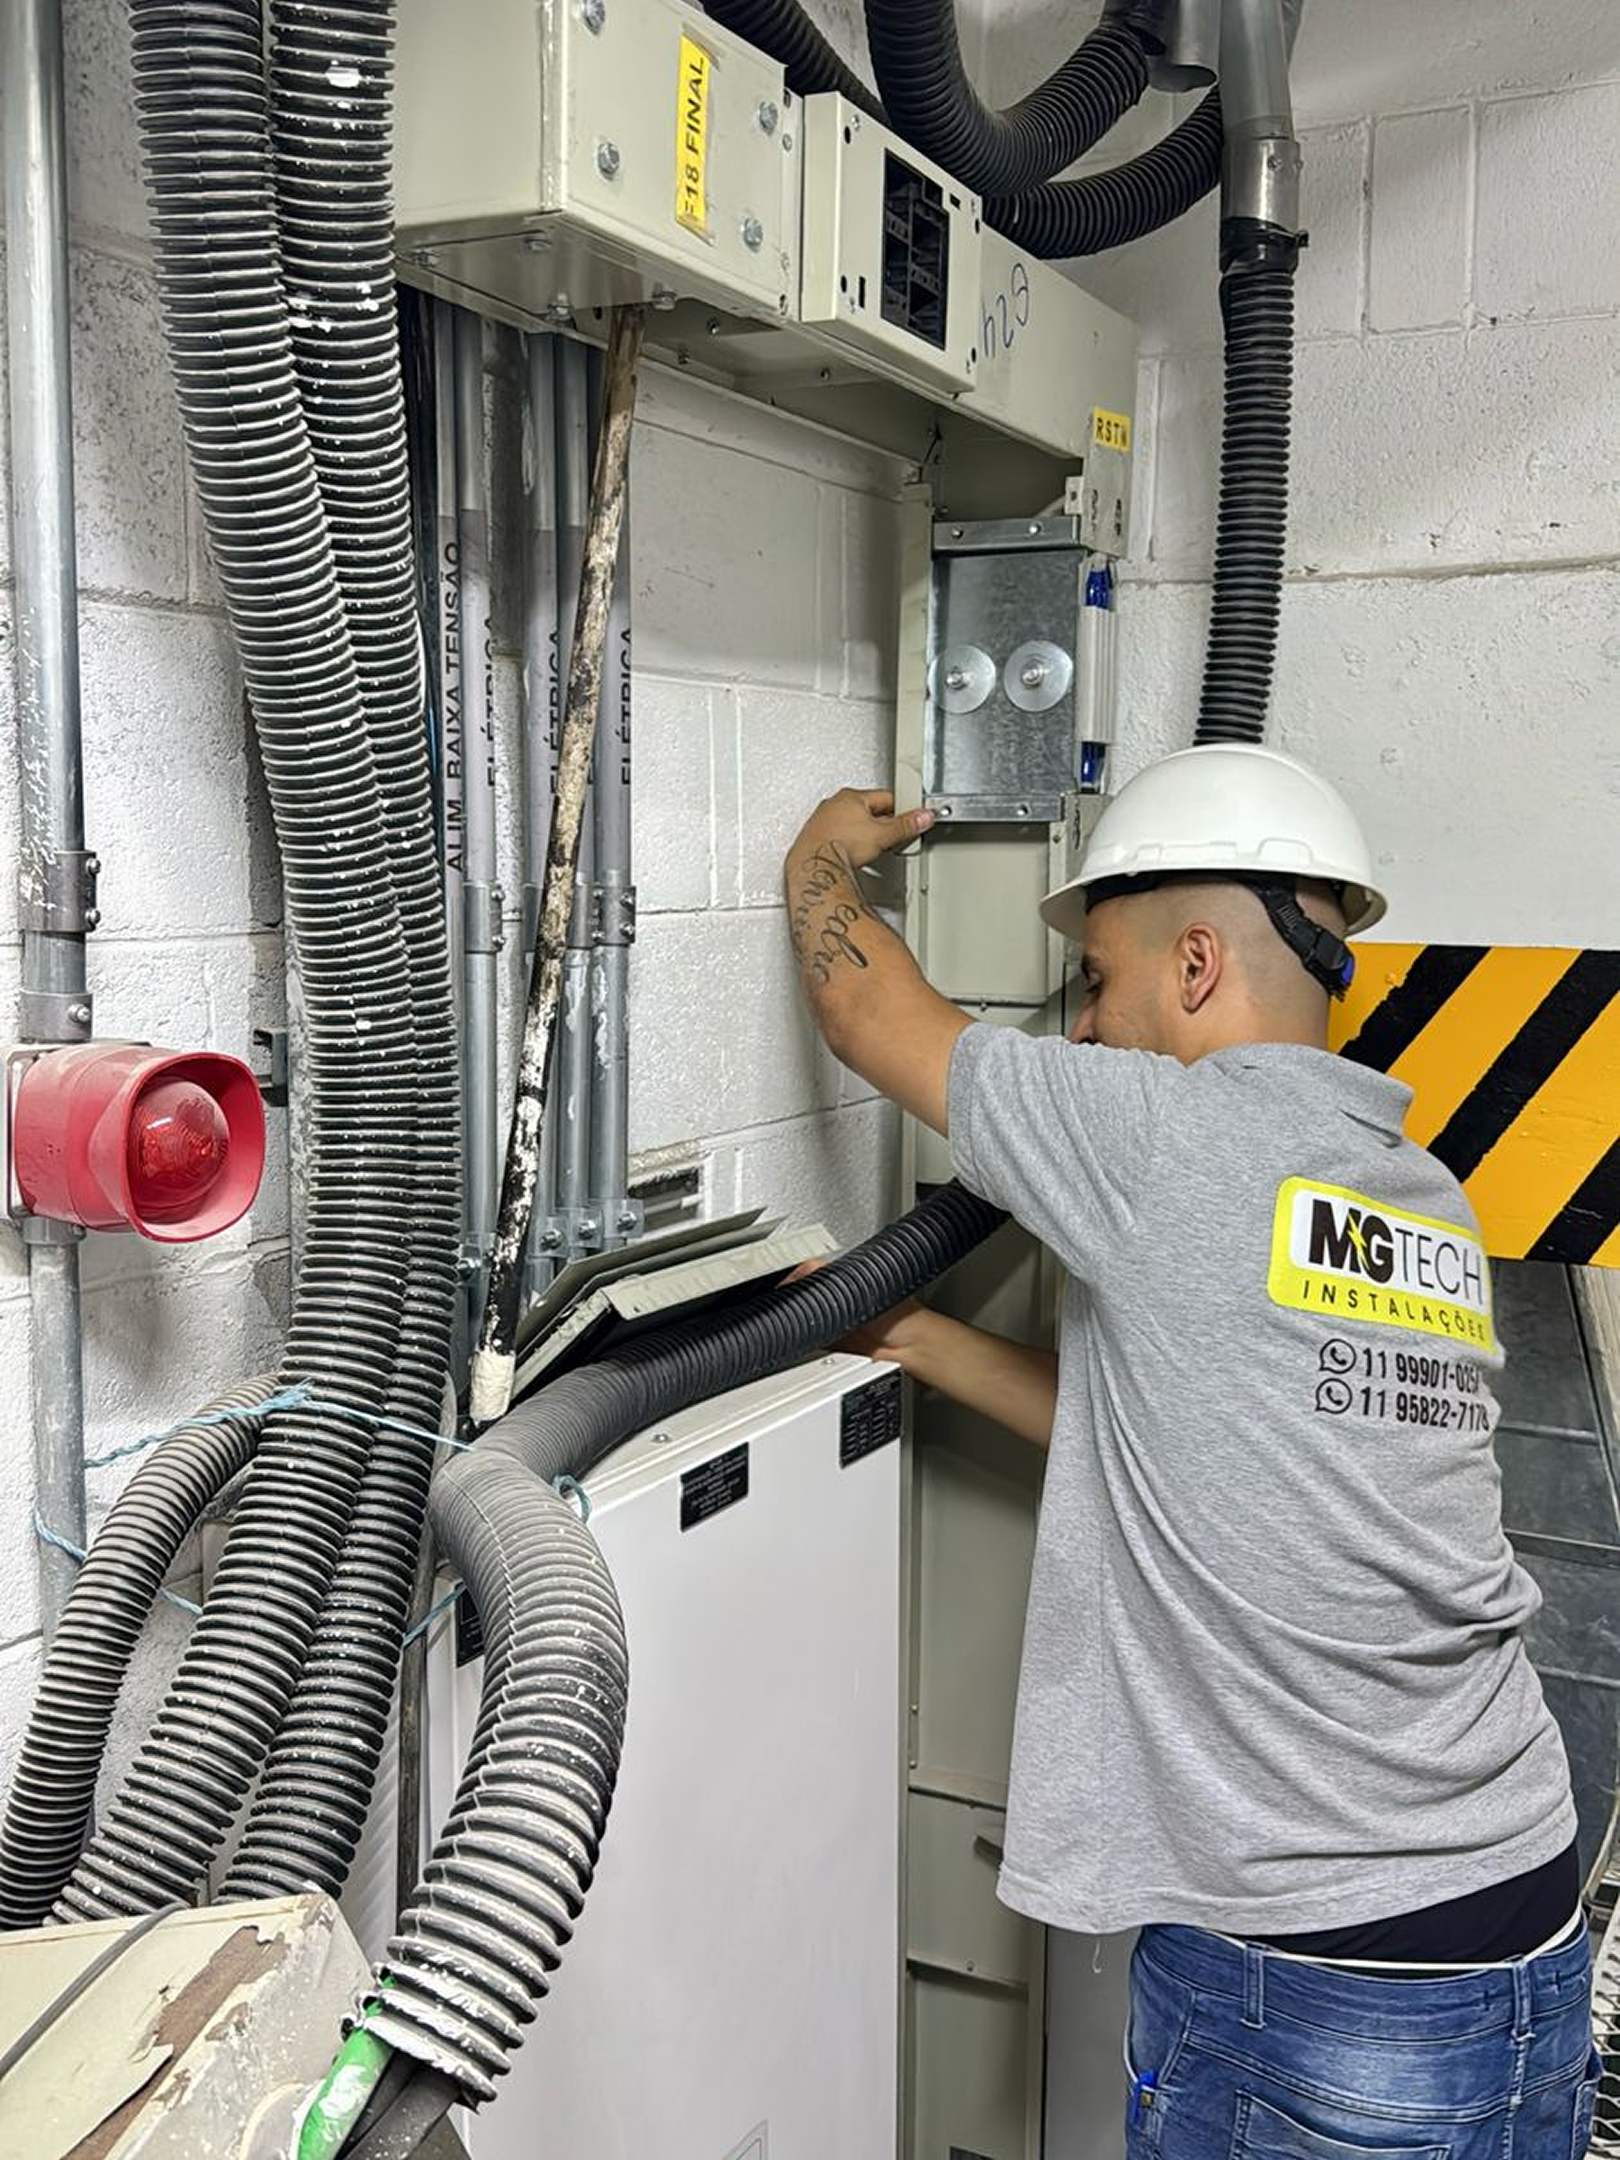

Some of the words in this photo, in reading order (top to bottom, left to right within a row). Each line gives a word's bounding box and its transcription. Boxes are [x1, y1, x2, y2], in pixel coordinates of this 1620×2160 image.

[686, 56, 704, 156] FINAL
[1302, 1280, 1484, 1341] INSTALAÇÕES
[1362, 1348, 1387, 1379] 11
[1360, 1386, 1387, 1418] 11
